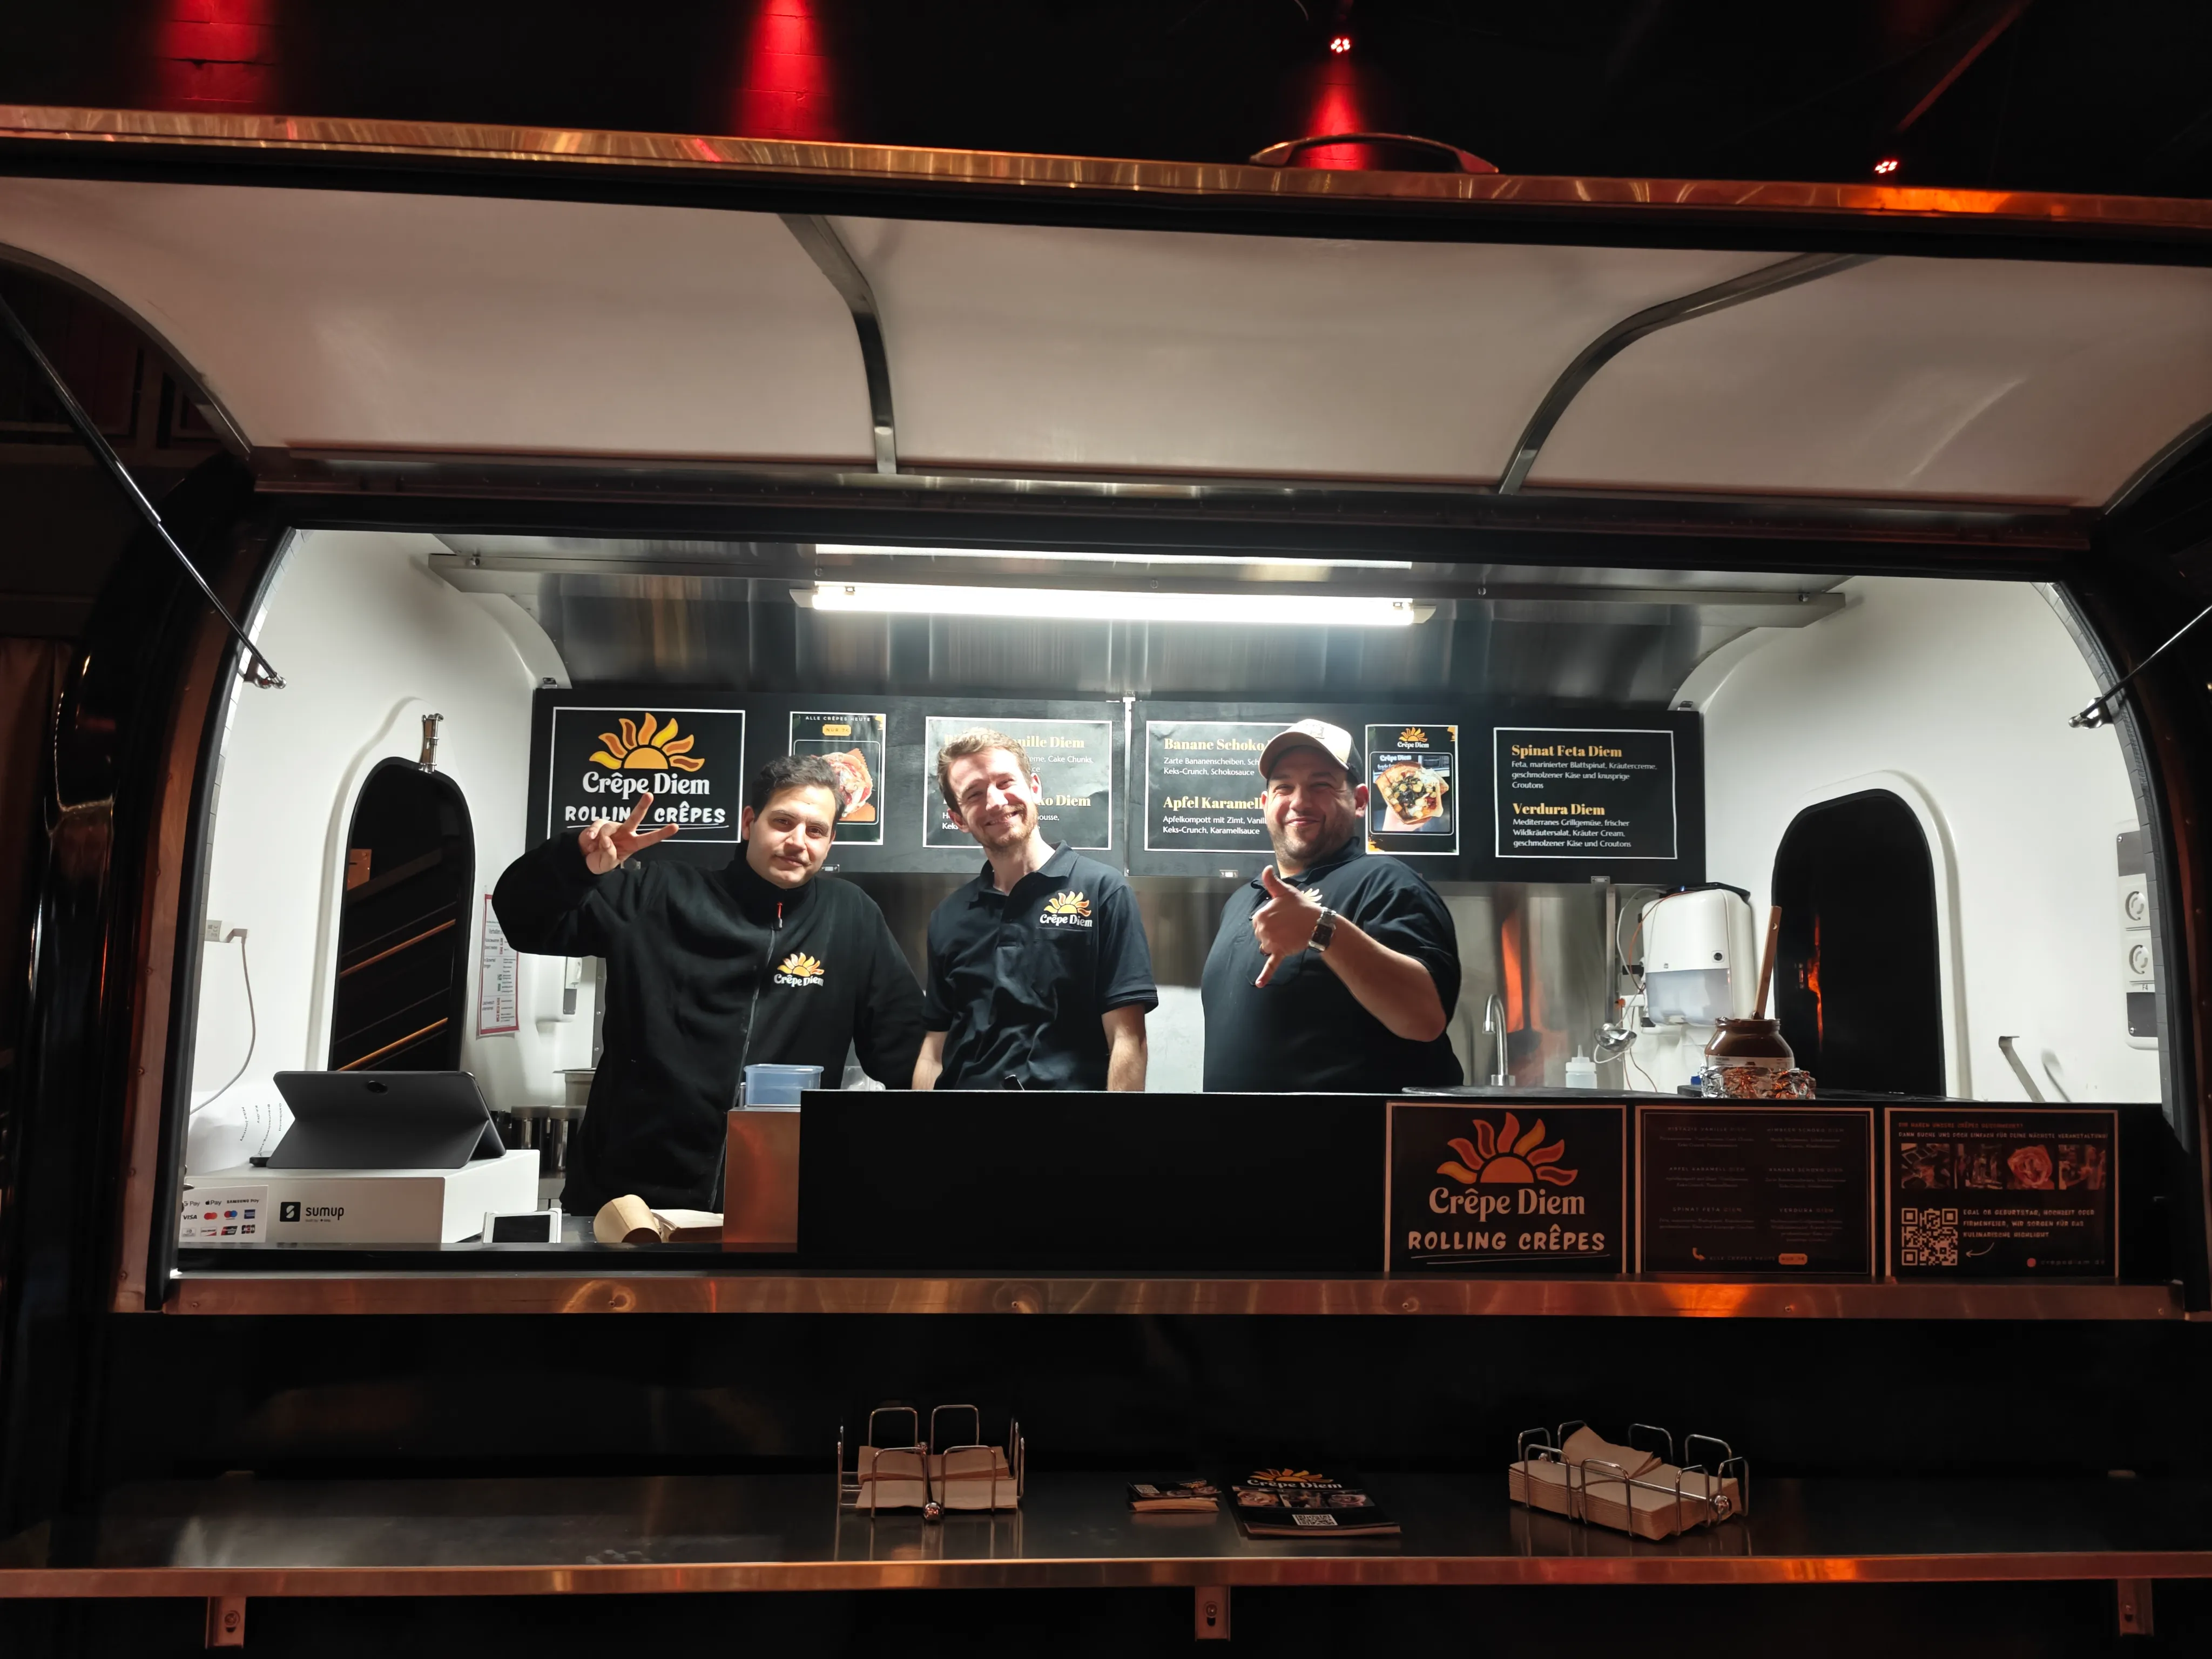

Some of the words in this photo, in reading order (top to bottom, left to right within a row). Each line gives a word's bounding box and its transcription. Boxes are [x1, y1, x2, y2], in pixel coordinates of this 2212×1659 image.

[1049, 736, 1085, 748] Diem
[1164, 738, 1214, 750] Banane
[1216, 739, 1265, 751] Schoko
[1512, 744, 1555, 759] Spinat
[1557, 745, 1586, 757] Feta
[1588, 745, 1622, 757] Diem
[1185, 758, 1246, 766] Bananenscheiben,
[1570, 761, 1608, 770] Blattspinat,
[1609, 762, 1657, 770] Kräutercreme,
[1163, 767, 1209, 776] Keks-Crunch,
[1512, 771, 1563, 780] geschmolzener
[1597, 772, 1630, 781] knusprige
[582, 771, 649, 800] Crêpe
[653, 772, 710, 795] Diem
[1056, 794, 1091, 806] Diem
[1163, 795, 1199, 812] Apfel
[1201, 797, 1263, 810] Karamell
[565, 806, 631, 821] ROLLIN
[654, 801, 726, 824] CRÊPES
[1512, 802, 1568, 815] Verdura
[1570, 803, 1606, 815] Diem
[1163, 815, 1211, 825] Apfelkompott
[1561, 819, 1603, 827] Grillgemüse,
[1163, 826, 1209, 834] Keks-Crunch,
[1513, 828, 1572, 837] Wildkräutersalat,
[1513, 839, 1565, 848] geschmolzener
[1600, 840, 1631, 848] Croutons
[1040, 914, 1068, 927] Crêpe
[1069, 914, 1092, 927] Diem
[774, 974, 802, 988] Crêpe
[803, 975, 824, 987] Diem
[1428, 1186, 1512, 1223] Crêpe
[1517, 1188, 1586, 1215] Diem
[305, 1207, 345, 1220] sumup
[1408, 1231, 1507, 1250] ROLLING
[1518, 1223, 1606, 1251] CRÊPES
[1246, 1479, 1296, 1488] Crêpe
